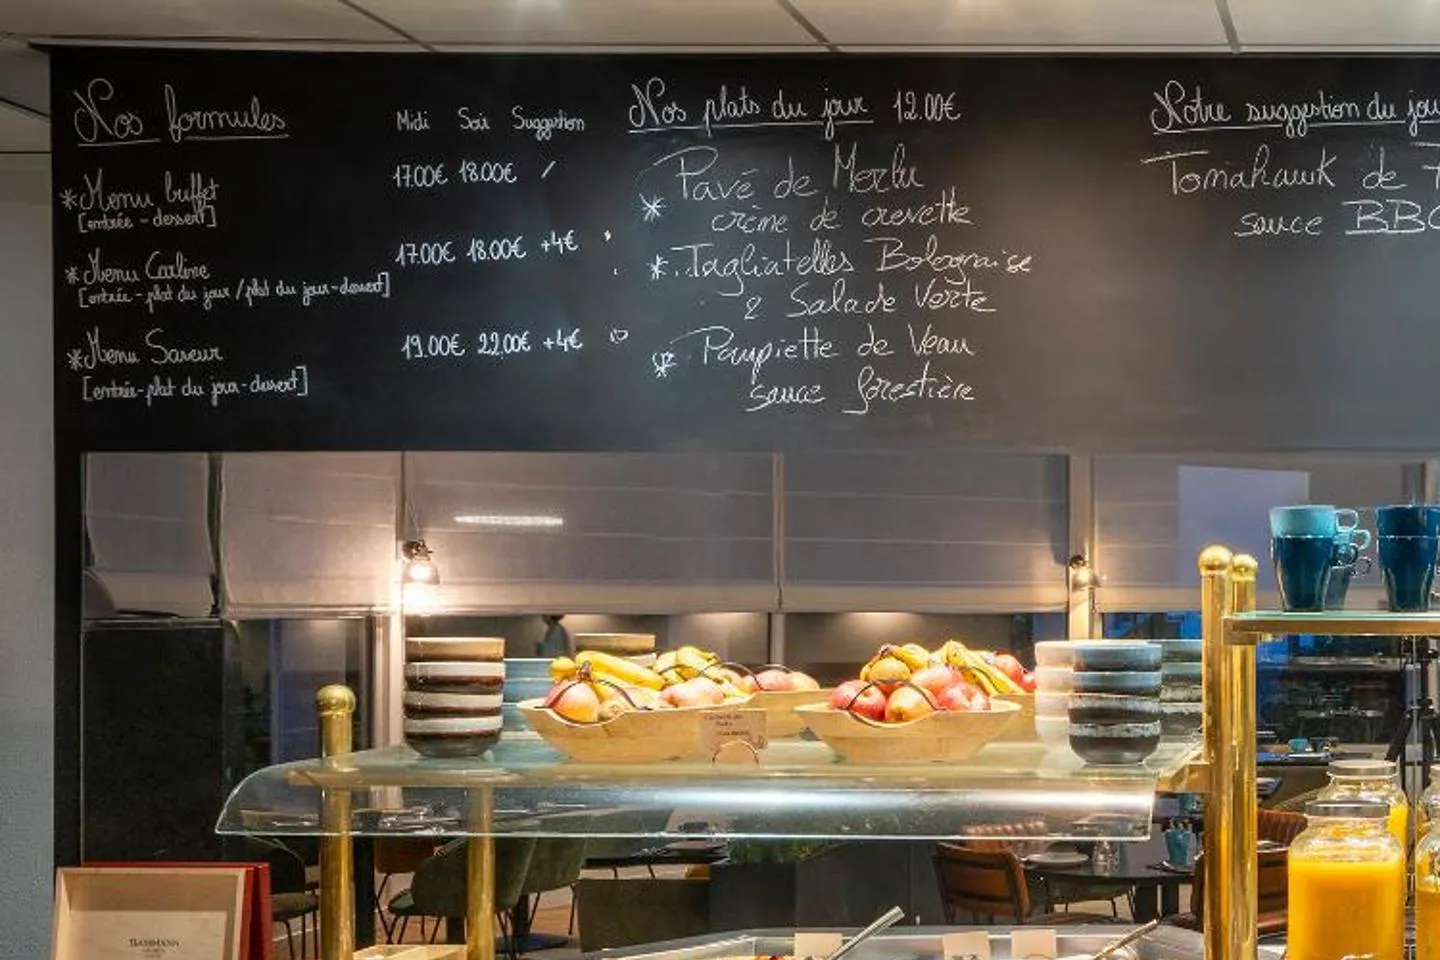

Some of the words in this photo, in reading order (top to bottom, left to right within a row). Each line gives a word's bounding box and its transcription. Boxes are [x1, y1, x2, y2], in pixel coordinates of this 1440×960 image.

[164, 84, 288, 143] formules
[397, 109, 431, 131] Midi
[458, 107, 491, 131] Soir
[511, 105, 586, 141] Suggestion
[629, 77, 687, 128] Nos
[702, 85, 761, 135] plats
[771, 90, 807, 119] du
[820, 88, 870, 140] jour
[893, 90, 961, 124] 12.00€
[1151, 80, 1232, 132] Notre
[1246, 91, 1361, 139] suggestion
[1366, 91, 1398, 121] du
[165, 170, 220, 214] buffet
[393, 164, 449, 188] 17.00€
[459, 159, 518, 184] 18.00€
[652, 145, 753, 201] Pavé
[774, 156, 819, 198] de
[831, 142, 924, 193] Merlu
[1141, 146, 1338, 195] Tomahawk
[1362, 146, 1407, 190] de
[712, 204, 788, 234] crème
[809, 197, 840, 229] de
[862, 186, 972, 226] crevette
[1234, 213, 1322, 238] sauce
[396, 241, 456, 267] 17.00€
[467, 236, 526, 263] 18.00€
[670, 238, 855, 297] Tagliatelles
[863, 234, 1033, 286] Bolognaise
[178, 284, 197, 301] du
[276, 280, 296, 295] du
[786, 277, 896, 318] Salade
[915, 272, 998, 311] Verte
[401, 334, 465, 360] 19.00€
[857, 324, 894, 356] de
[908, 323, 974, 356] Veau
[182, 376, 203, 396] du
[746, 382, 826, 412] sauce
[842, 360, 975, 414] forestière
